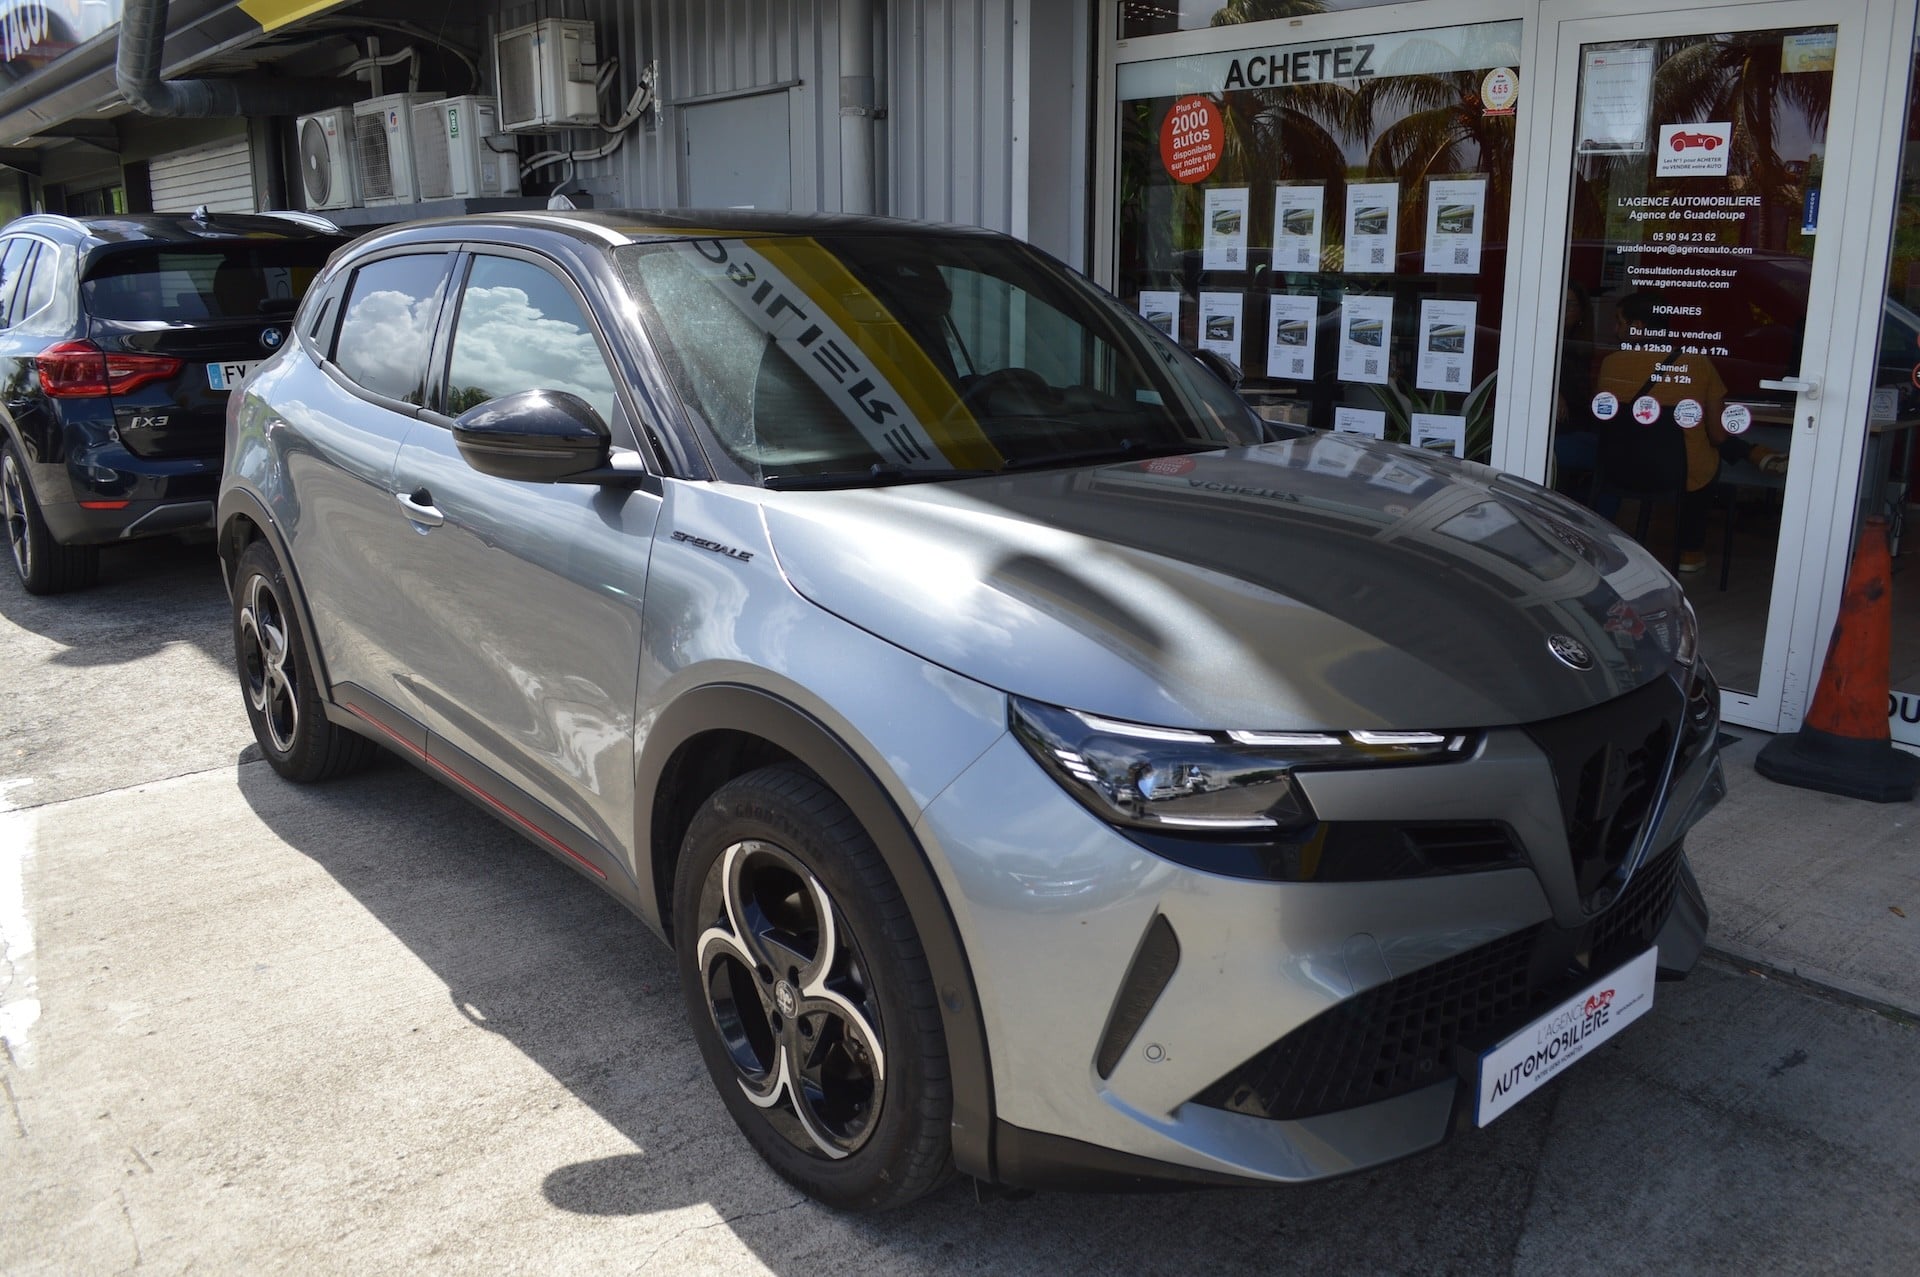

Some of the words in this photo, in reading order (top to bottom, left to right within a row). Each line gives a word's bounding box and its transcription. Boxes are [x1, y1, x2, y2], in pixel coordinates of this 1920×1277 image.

[1224, 43, 1375, 90] ACHETEZ
[1176, 104, 1191, 114] Plus
[1192, 100, 1201, 108] de
[1171, 108, 1208, 135] 2000
[1173, 129, 1210, 149] autos
[1173, 144, 1212, 160] disponibles
[1171, 162, 1182, 171] sur
[1184, 157, 1202, 167] notre
[1203, 152, 1216, 162] site
[1179, 164, 1206, 178] internet
[1617, 197, 1669, 207] L'AGENCE
[1671, 196, 1761, 207] AUTOMOBILIERE
[1629, 210, 1666, 222] Agence
[1668, 210, 1681, 219] de
[1683, 209, 1746, 222] Guadeloupe
[1652, 232, 1664, 241] 05
[1665, 232, 1677, 241] 90
[1678, 232, 1690, 242] 94
[1691, 232, 1703, 242] 23
[1704, 232, 1717, 242] 62
[1616, 243, 1753, 256] guadeloupe@agenceauto.com
[1631, 278, 1730, 289] www.agenceauto.com
[1652, 305, 1703, 316] HORAIRES
[1629, 326, 1642, 336] Du
[1643, 327, 1667, 338] lundi
[1668, 330, 1680, 339] au
[1681, 330, 1722, 341] vendredi
[1620, 342, 1633, 352] 9h
[1634, 342, 1641, 352] à
[1643, 343, 1673, 353] 12h30
[1680, 345, 1699, 355] 14h
[1700, 345, 1708, 355] à
[1710, 346, 1729, 356] 17h
[1654, 362, 1689, 373] Samedi
[1650, 373, 1663, 383] 9h
[1664, 373, 1671, 383] à
[1673, 375, 1692, 385] 12h
